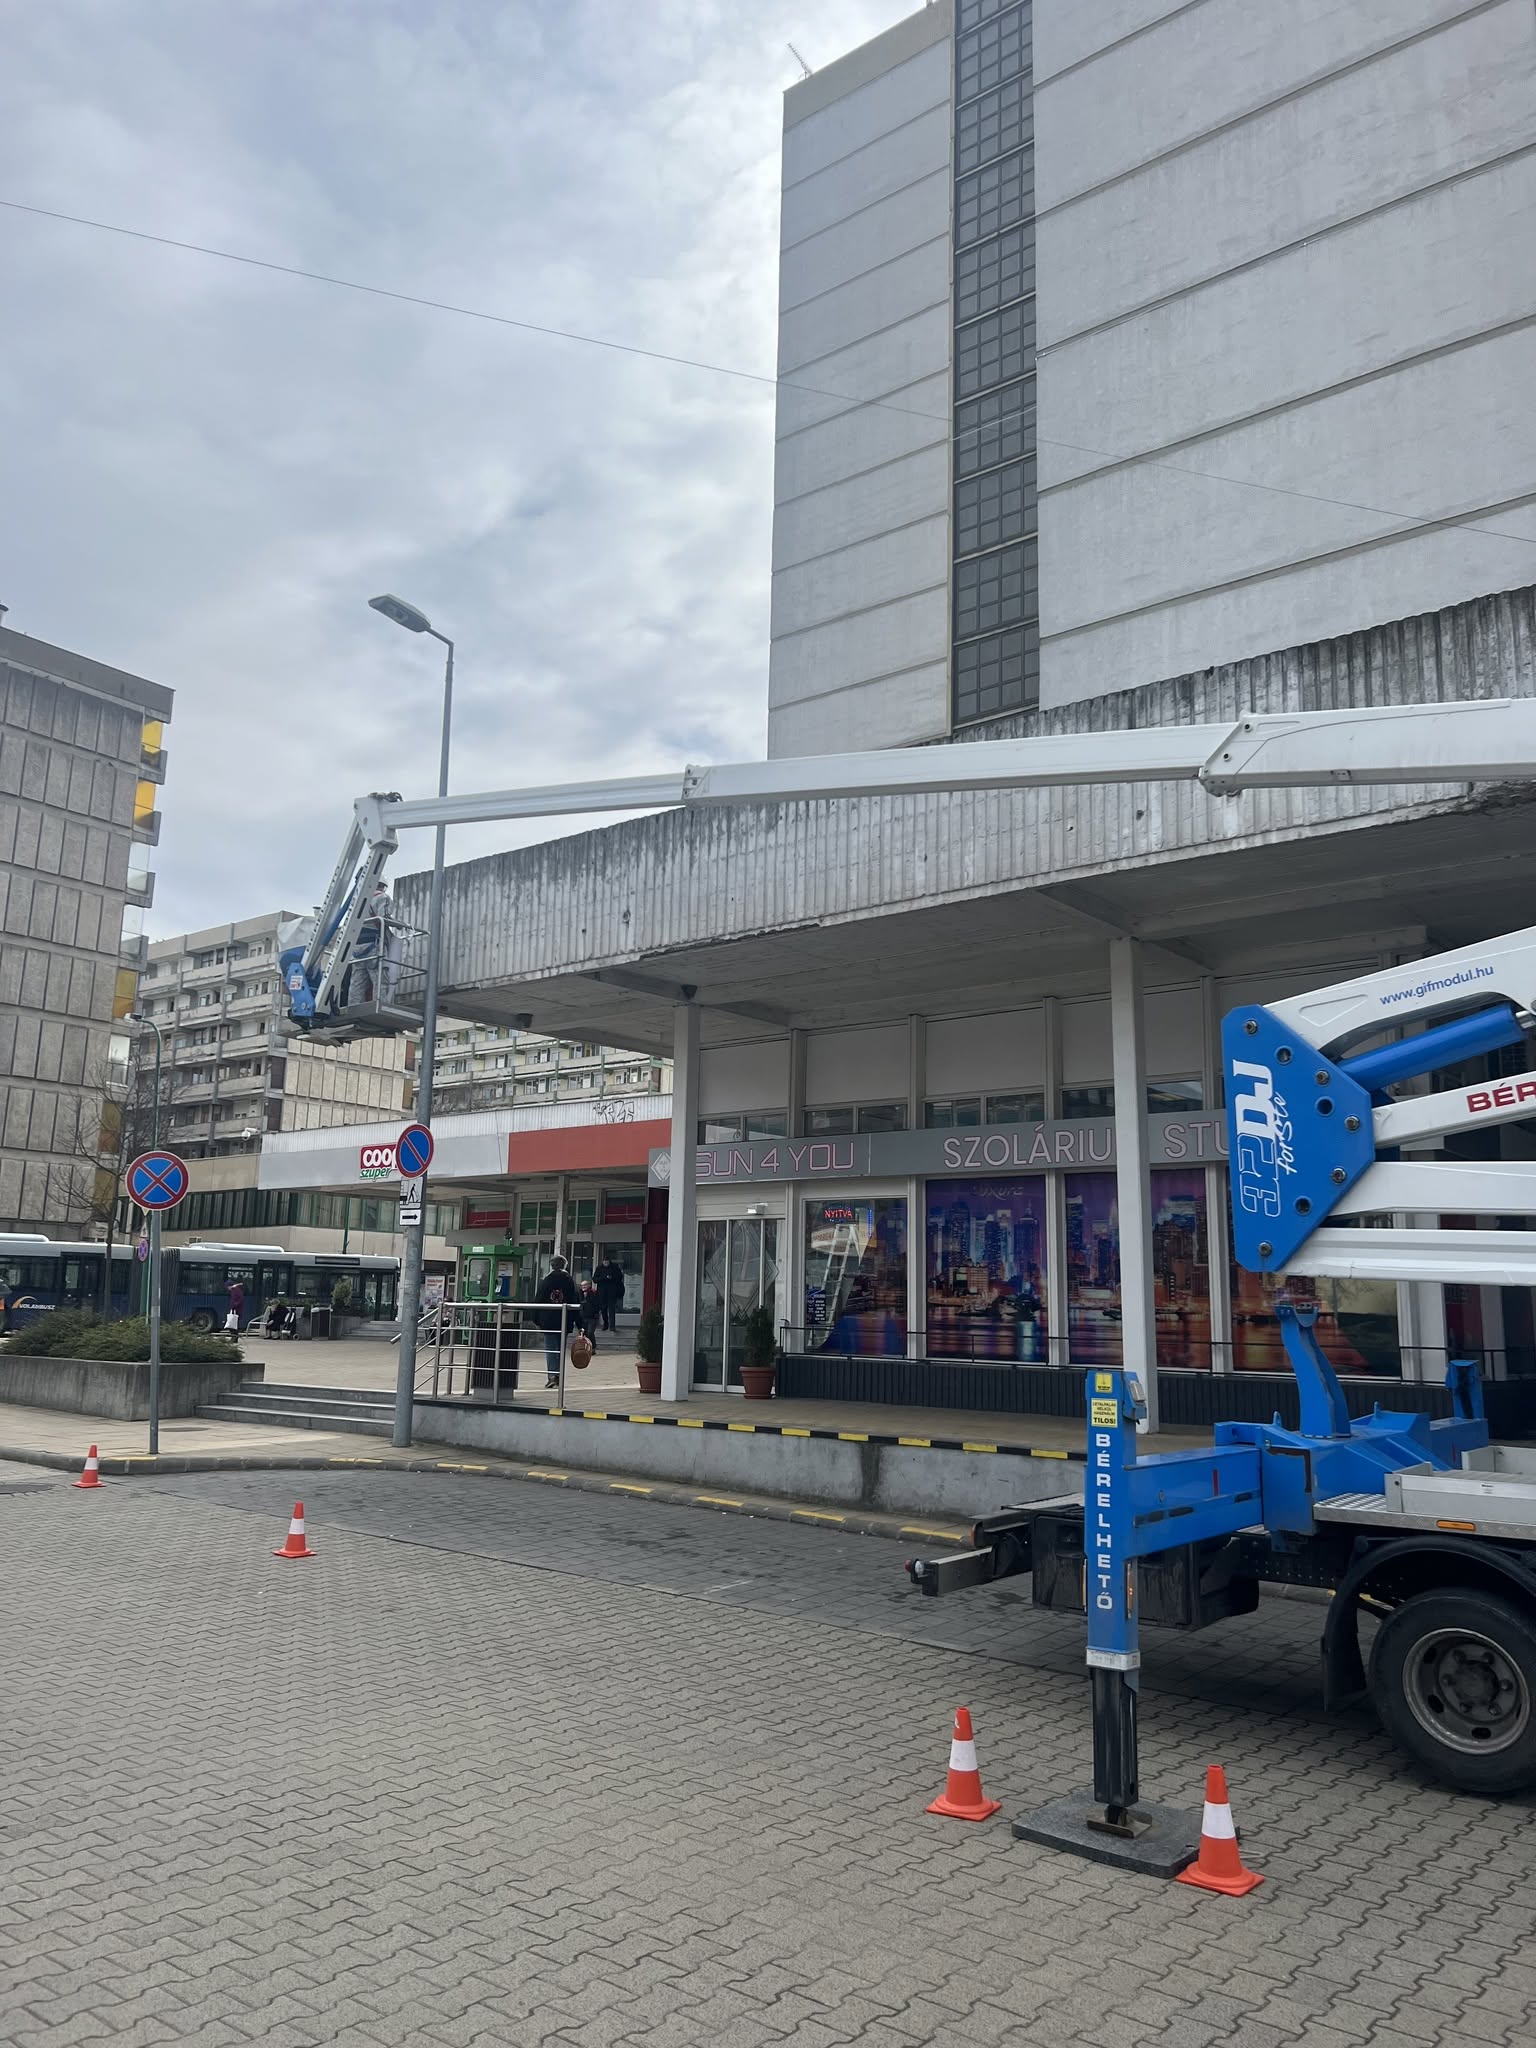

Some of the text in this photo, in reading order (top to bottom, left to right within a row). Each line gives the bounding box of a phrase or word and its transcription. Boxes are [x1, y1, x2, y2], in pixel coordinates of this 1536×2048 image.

[1380, 966, 1494, 1005] www.gifmodul.hu
[1466, 1082, 1536, 1112] BÉR
[696, 1149, 753, 1177] SUN
[760, 1147, 780, 1173] 4
[788, 1142, 854, 1172] YOU
[943, 1121, 1231, 1169] SZOLÁRIU STU
[360, 1167, 390, 1179] szuper
[824, 1208, 853, 1219] NYITVA
[1095, 1433, 1113, 1610] BÉRELHETŐ
